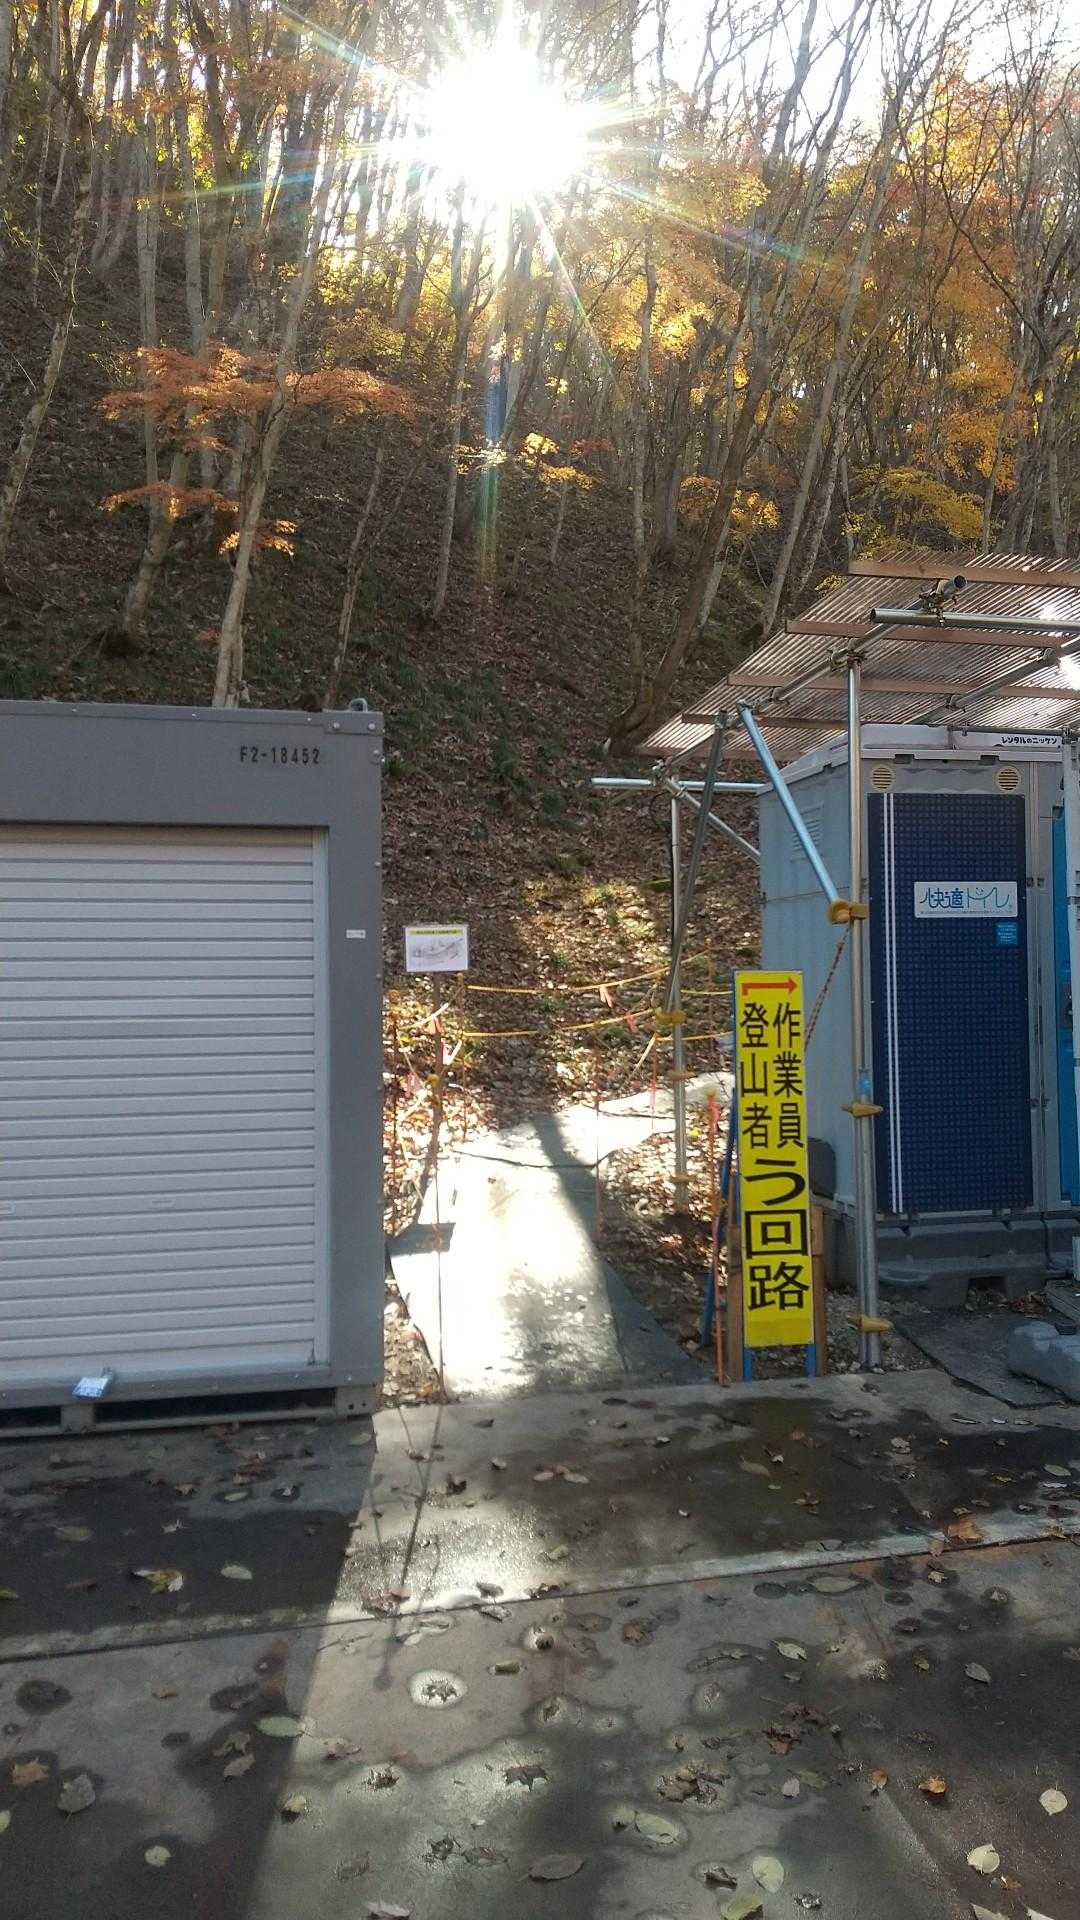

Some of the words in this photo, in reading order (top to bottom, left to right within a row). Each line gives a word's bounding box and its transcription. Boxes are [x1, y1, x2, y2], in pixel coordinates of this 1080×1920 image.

[240, 745, 320, 765] F2-18452
[1001, 736, 1058, 745] レンタルのニッケン
[740, 1002, 772, 1149] 登山者
[773, 1002, 804, 1149] 作業員
[745, 1159, 809, 1311] う回路
